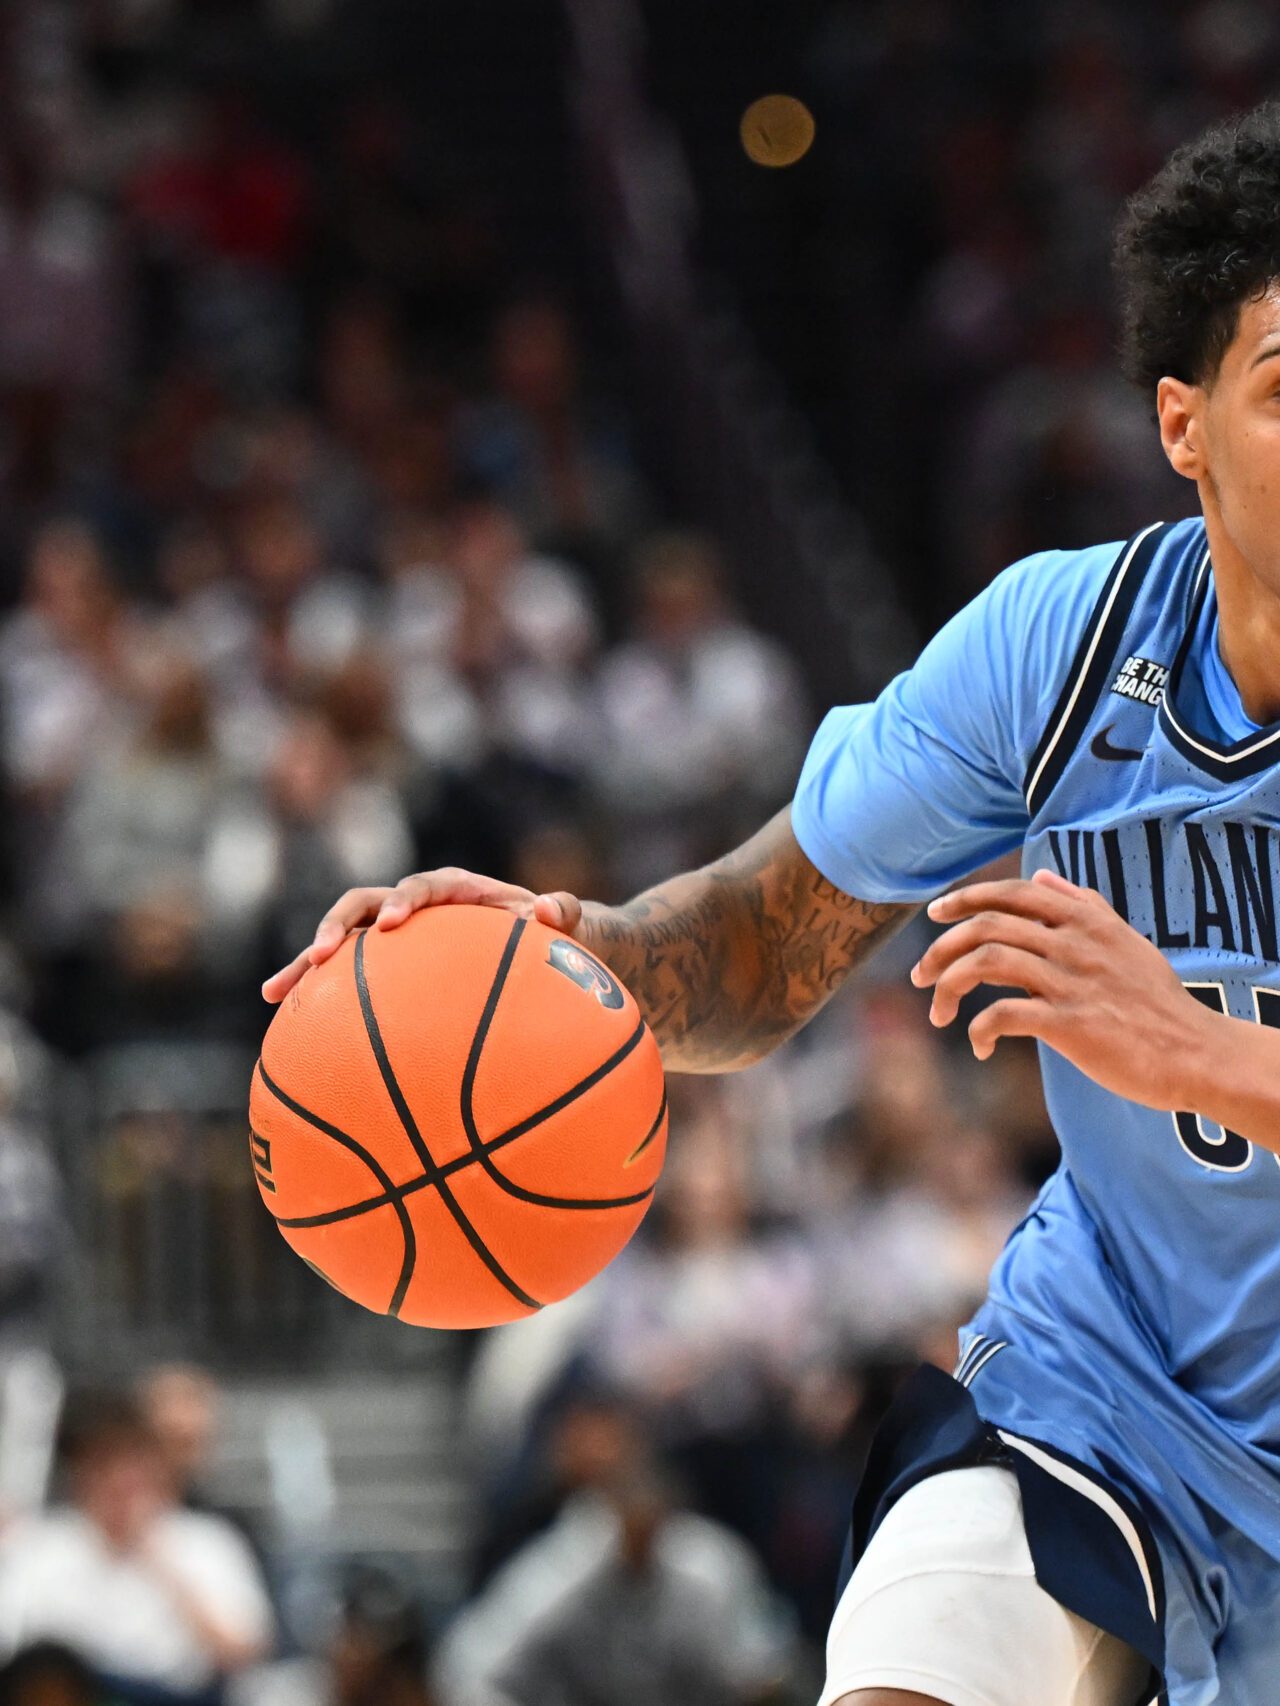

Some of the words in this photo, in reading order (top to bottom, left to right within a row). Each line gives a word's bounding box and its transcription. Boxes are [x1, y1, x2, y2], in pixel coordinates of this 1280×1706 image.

[1120, 656, 1144, 677] BE
[1143, 662, 1170, 686] TH
[1110, 674, 1162, 706] HANG
